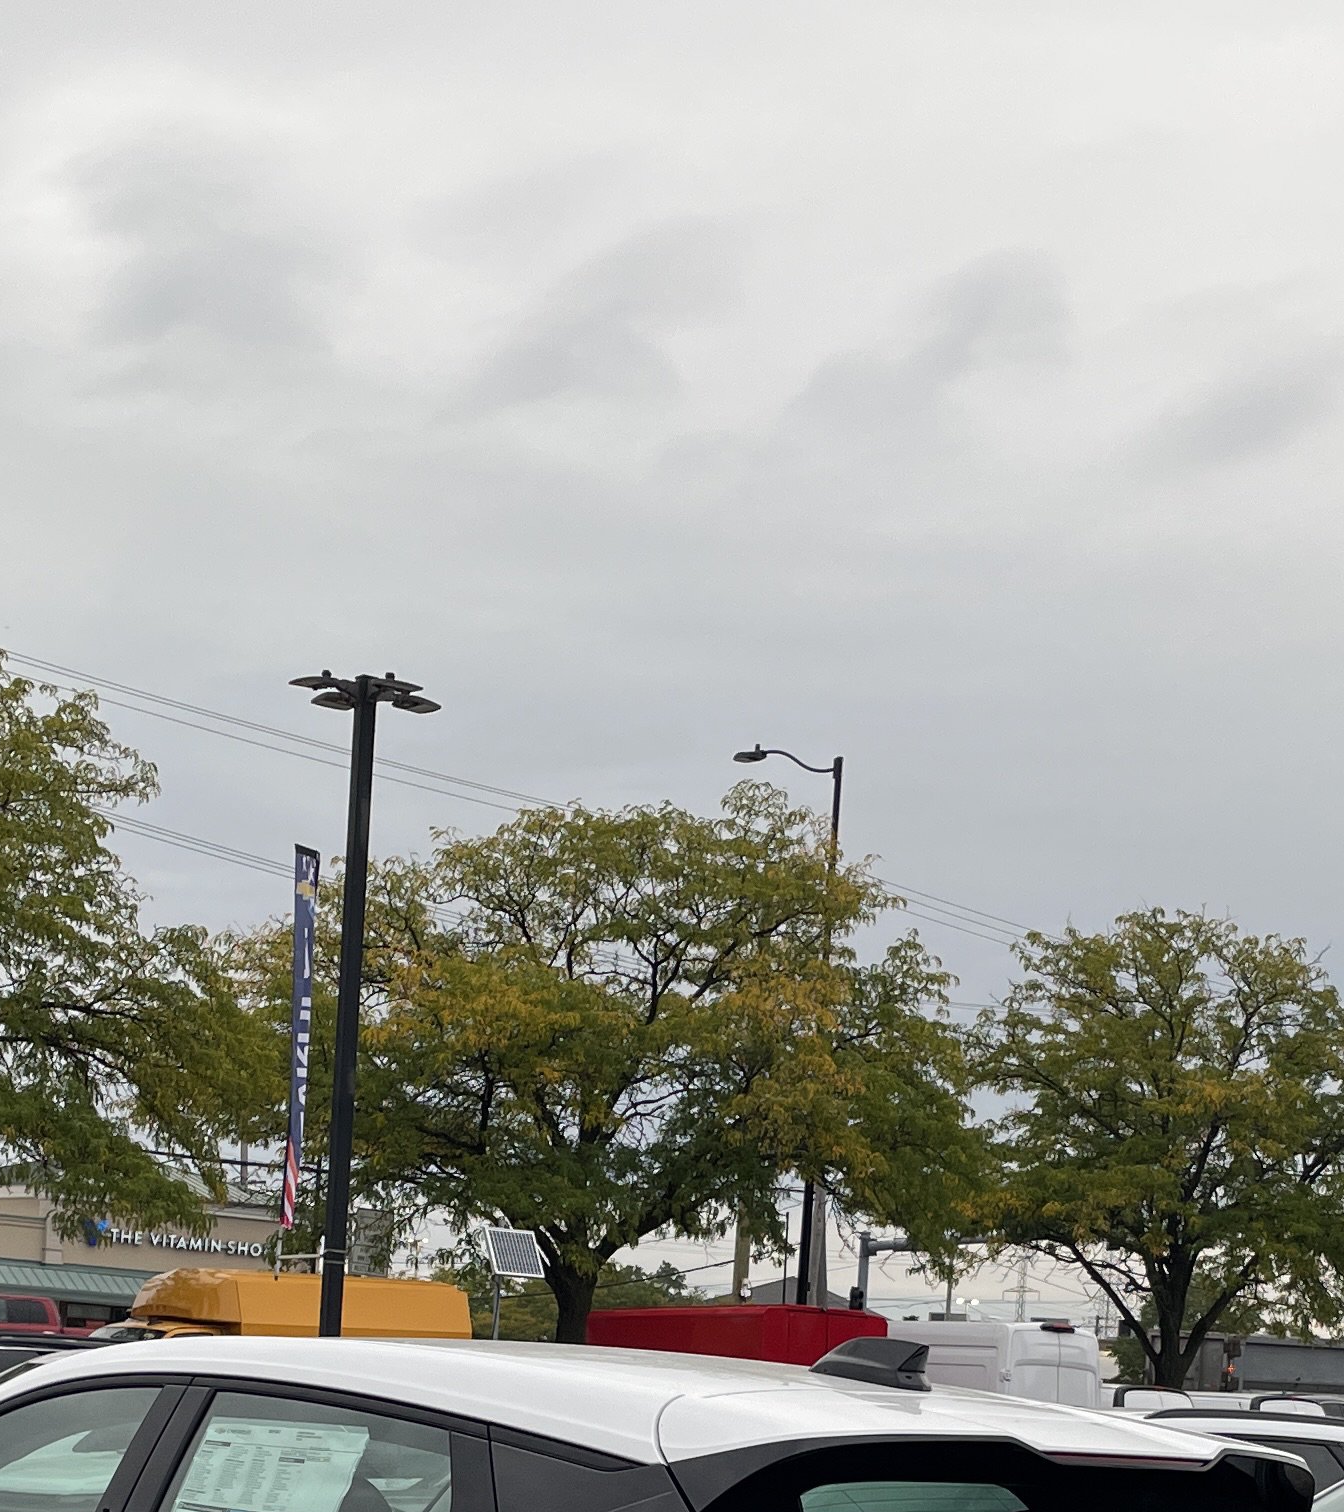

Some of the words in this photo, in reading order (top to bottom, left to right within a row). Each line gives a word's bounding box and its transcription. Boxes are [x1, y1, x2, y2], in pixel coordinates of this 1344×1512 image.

[111, 1228, 143, 1245] THE
[151, 1232, 222, 1253] VITAMIN
[227, 1240, 268, 1257] SHO
